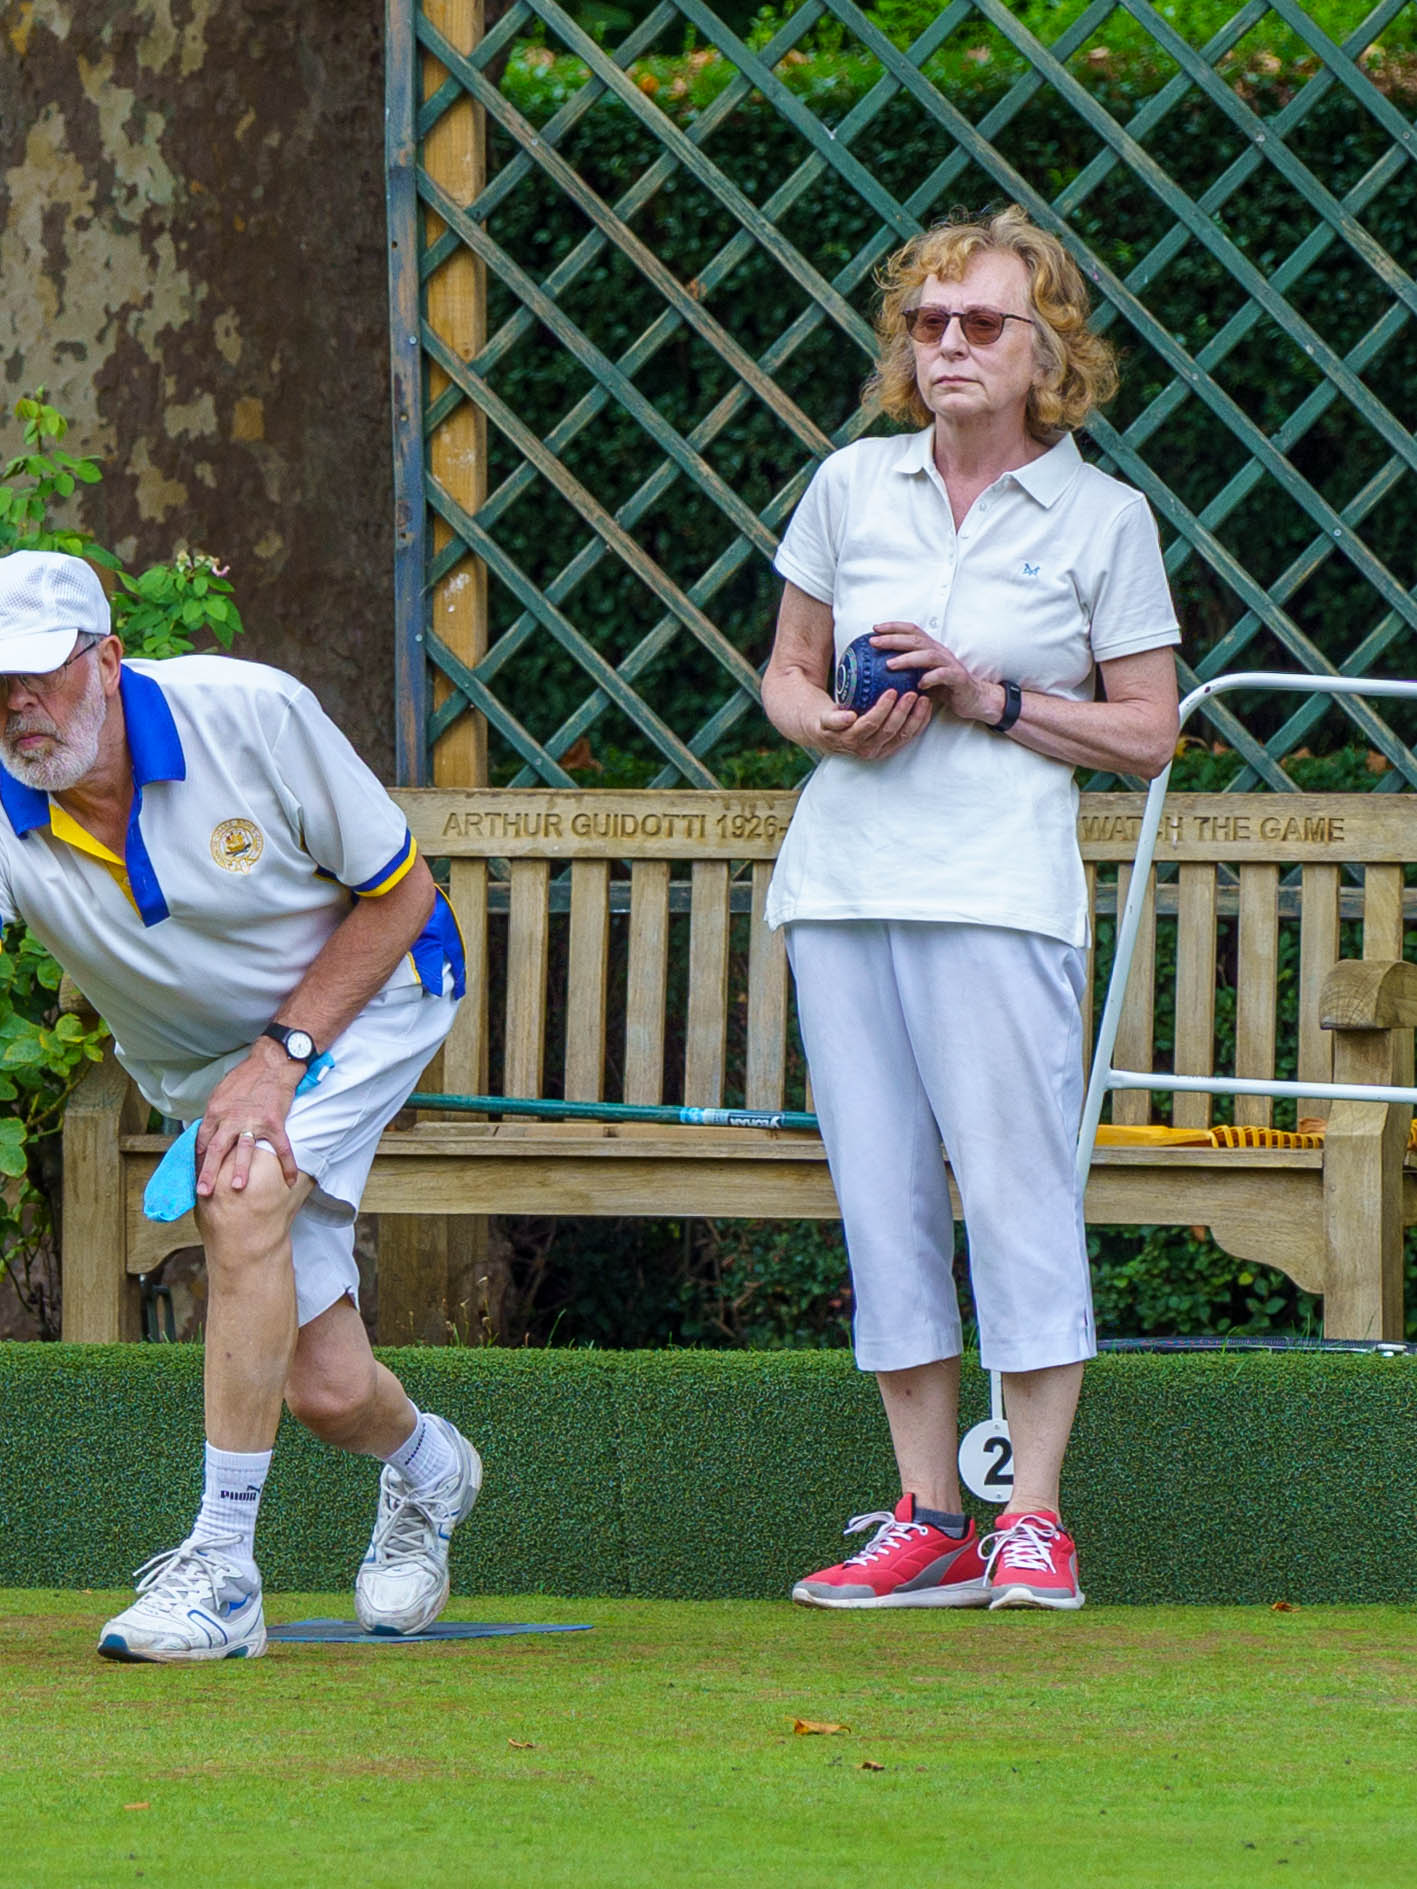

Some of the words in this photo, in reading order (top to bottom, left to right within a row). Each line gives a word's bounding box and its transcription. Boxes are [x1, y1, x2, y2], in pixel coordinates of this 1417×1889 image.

[442, 812, 563, 839] ARTHUR
[571, 812, 707, 840] GUIDOTTI
[716, 814, 794, 841] 1926-
[1080, 815, 1184, 842] WATH
[1193, 815, 1251, 842] THE
[1259, 815, 1345, 842] GAME
[983, 1435, 1014, 1486] 2
